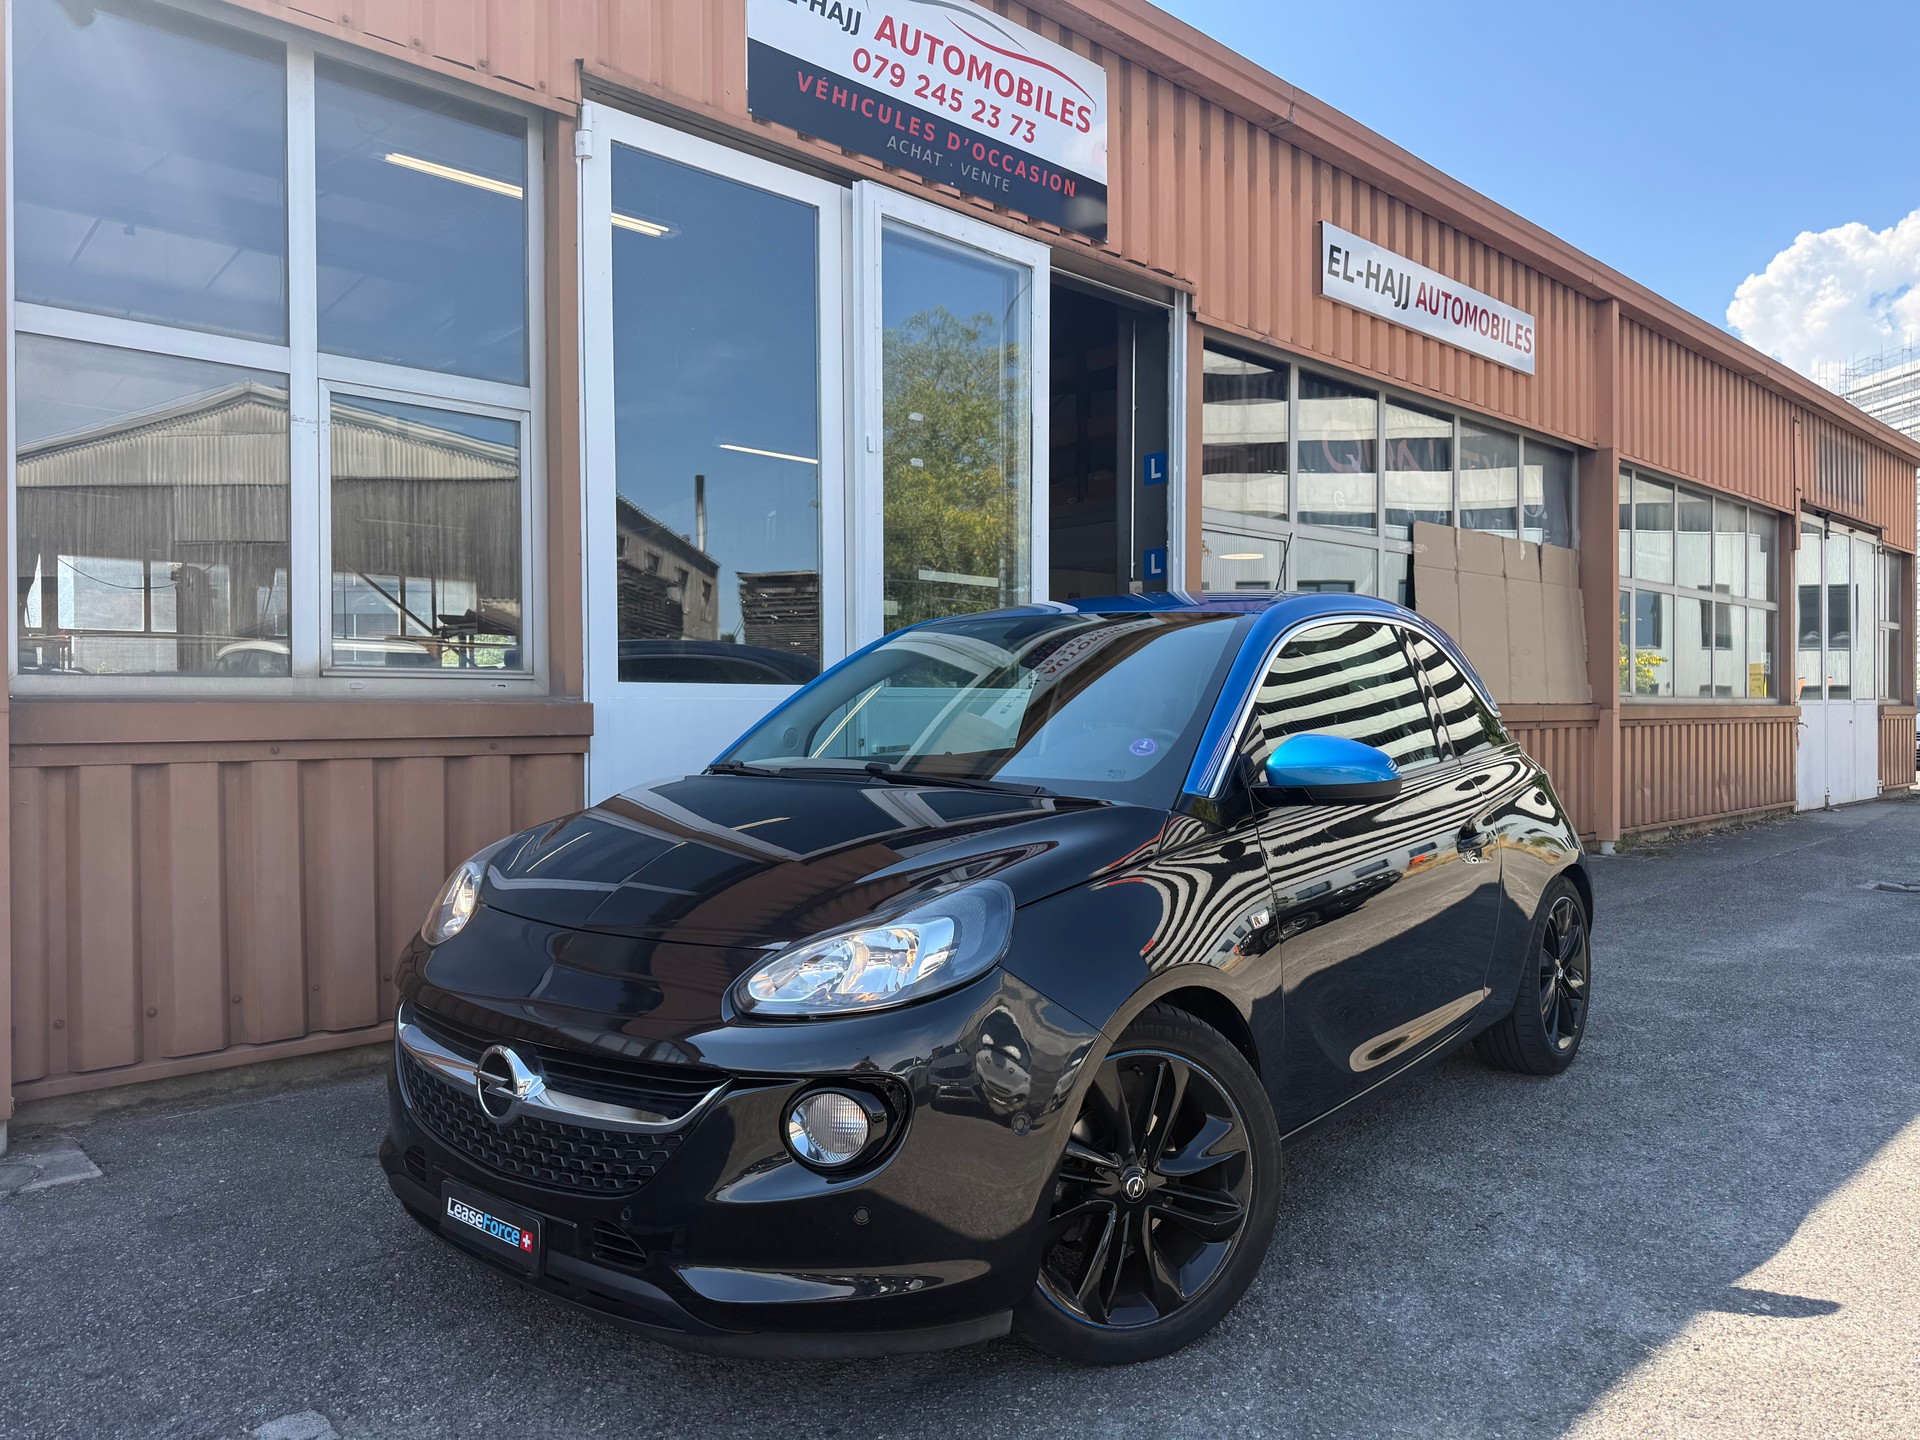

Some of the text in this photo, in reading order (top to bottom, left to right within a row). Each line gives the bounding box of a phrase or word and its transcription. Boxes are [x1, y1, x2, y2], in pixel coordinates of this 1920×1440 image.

[853, 48, 1037, 144] 079 245 23 73
[873, 15, 1091, 133] AUTOMOBILES
[797, 71, 1076, 198] VÉHICULES D'OCCASION
[887, 136, 1010, 193] ACHAT VENTE
[1327, 244, 1532, 354] EL-HAJJ AUTOMOBILES
[1151, 458, 1161, 479] L
[1151, 553, 1161, 574] L
[447, 1197, 520, 1245] LeaseForce
